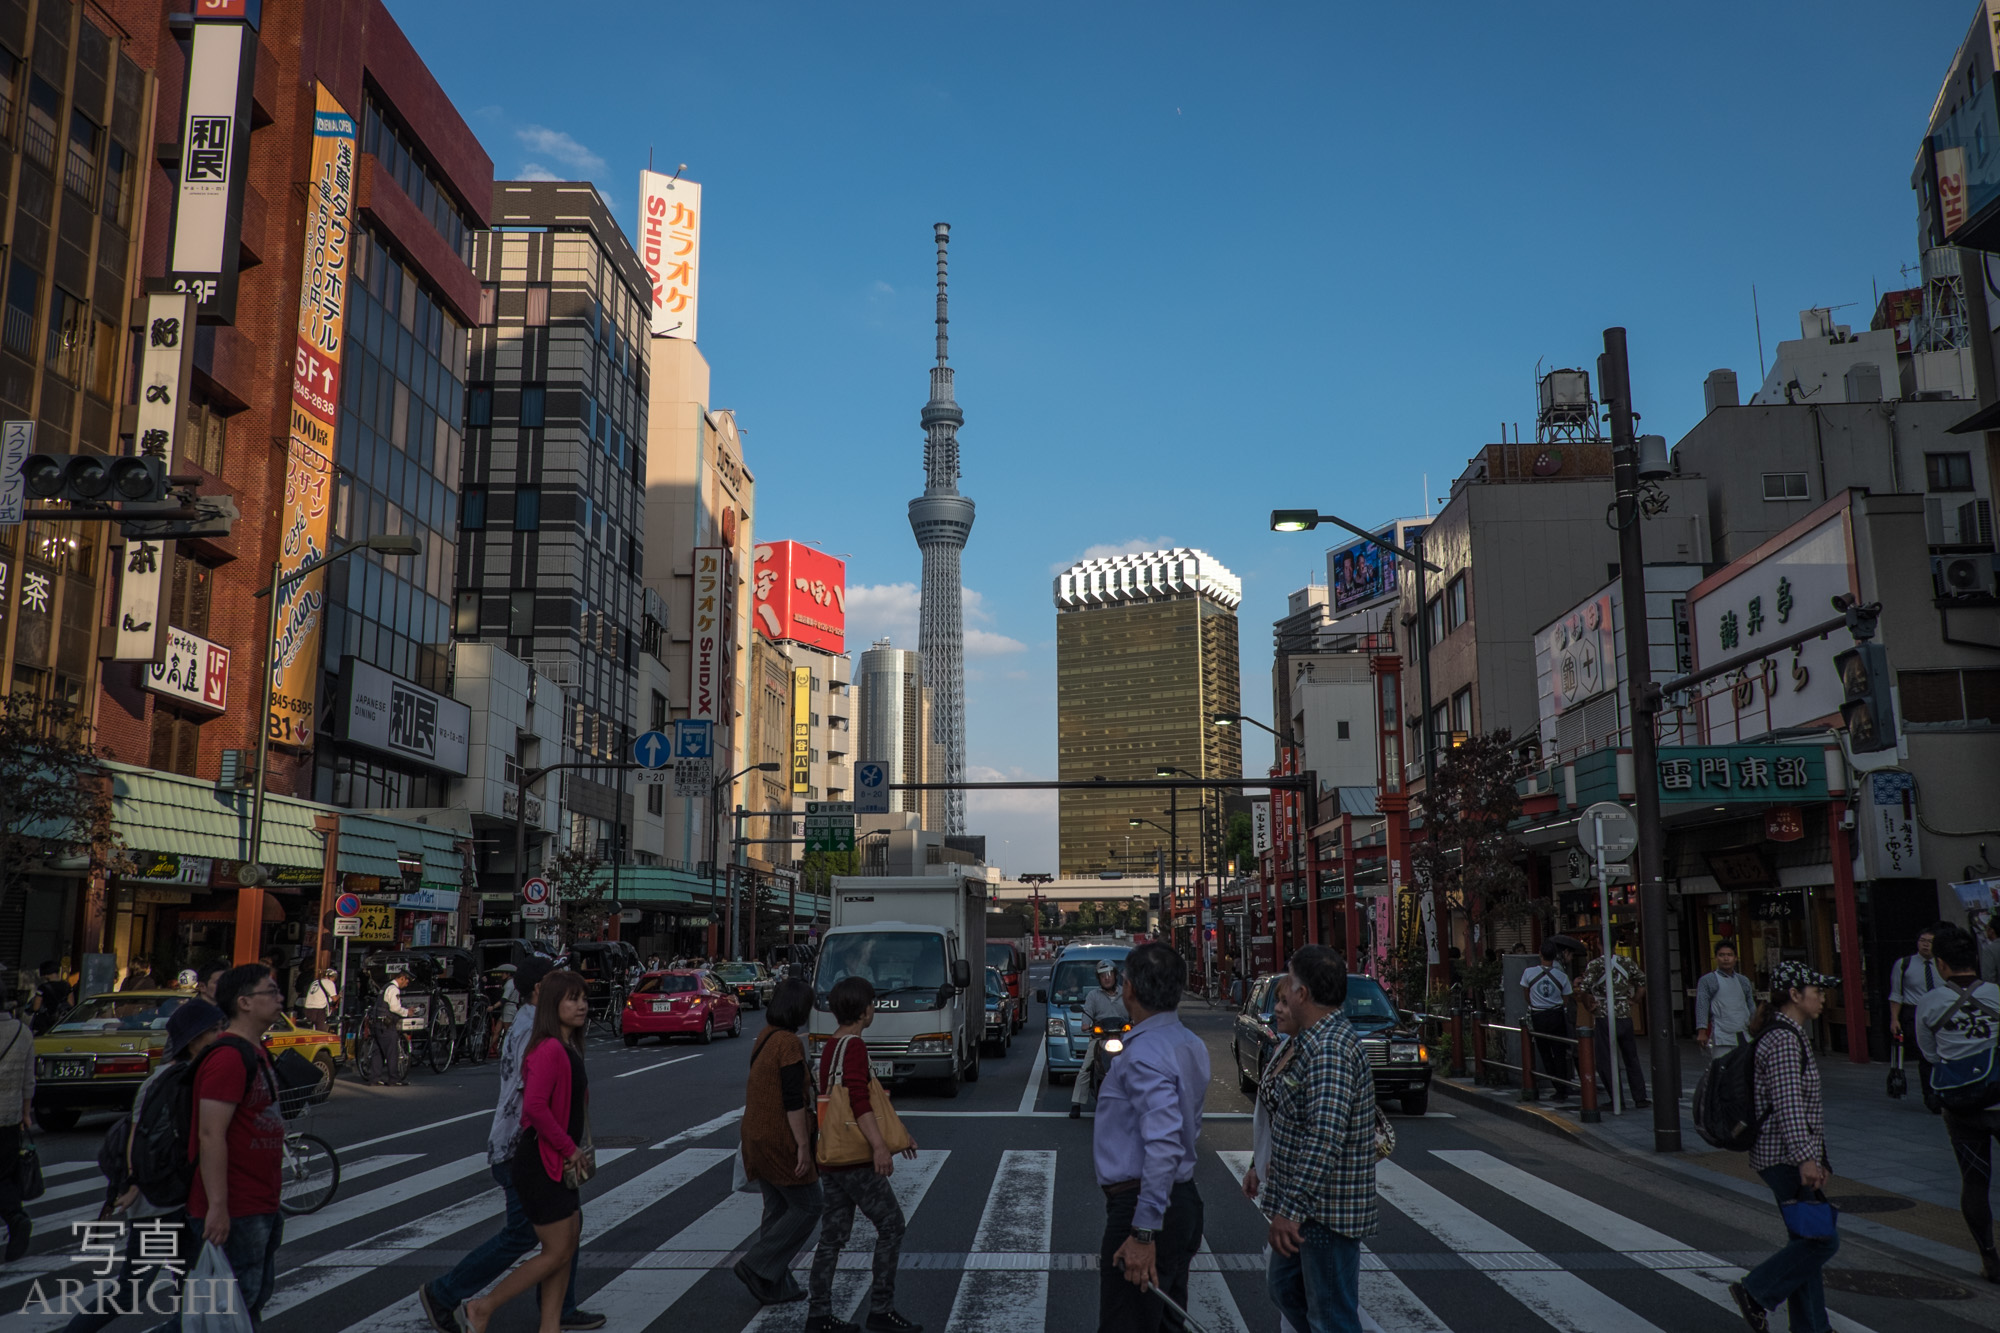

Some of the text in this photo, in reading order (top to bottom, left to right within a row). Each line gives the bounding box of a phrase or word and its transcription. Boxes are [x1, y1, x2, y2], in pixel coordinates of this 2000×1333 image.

[188, 118, 229, 180] 和民
[665, 202, 696, 313] カラオケ
[296, 346, 319, 383] 5F
[22, 572, 49, 613] 茶
[697, 555, 717, 632] カラオケ
[210, 650, 226, 675] 1F
[698, 637, 713, 715] SHIDAX
[354, 693, 387, 712] JAPANESE
[354, 706, 376, 721] DINING
[391, 690, 436, 752] 和民
[1659, 756, 1806, 790] 雷門東部
[58, 1066, 86, 1077] 36-75
